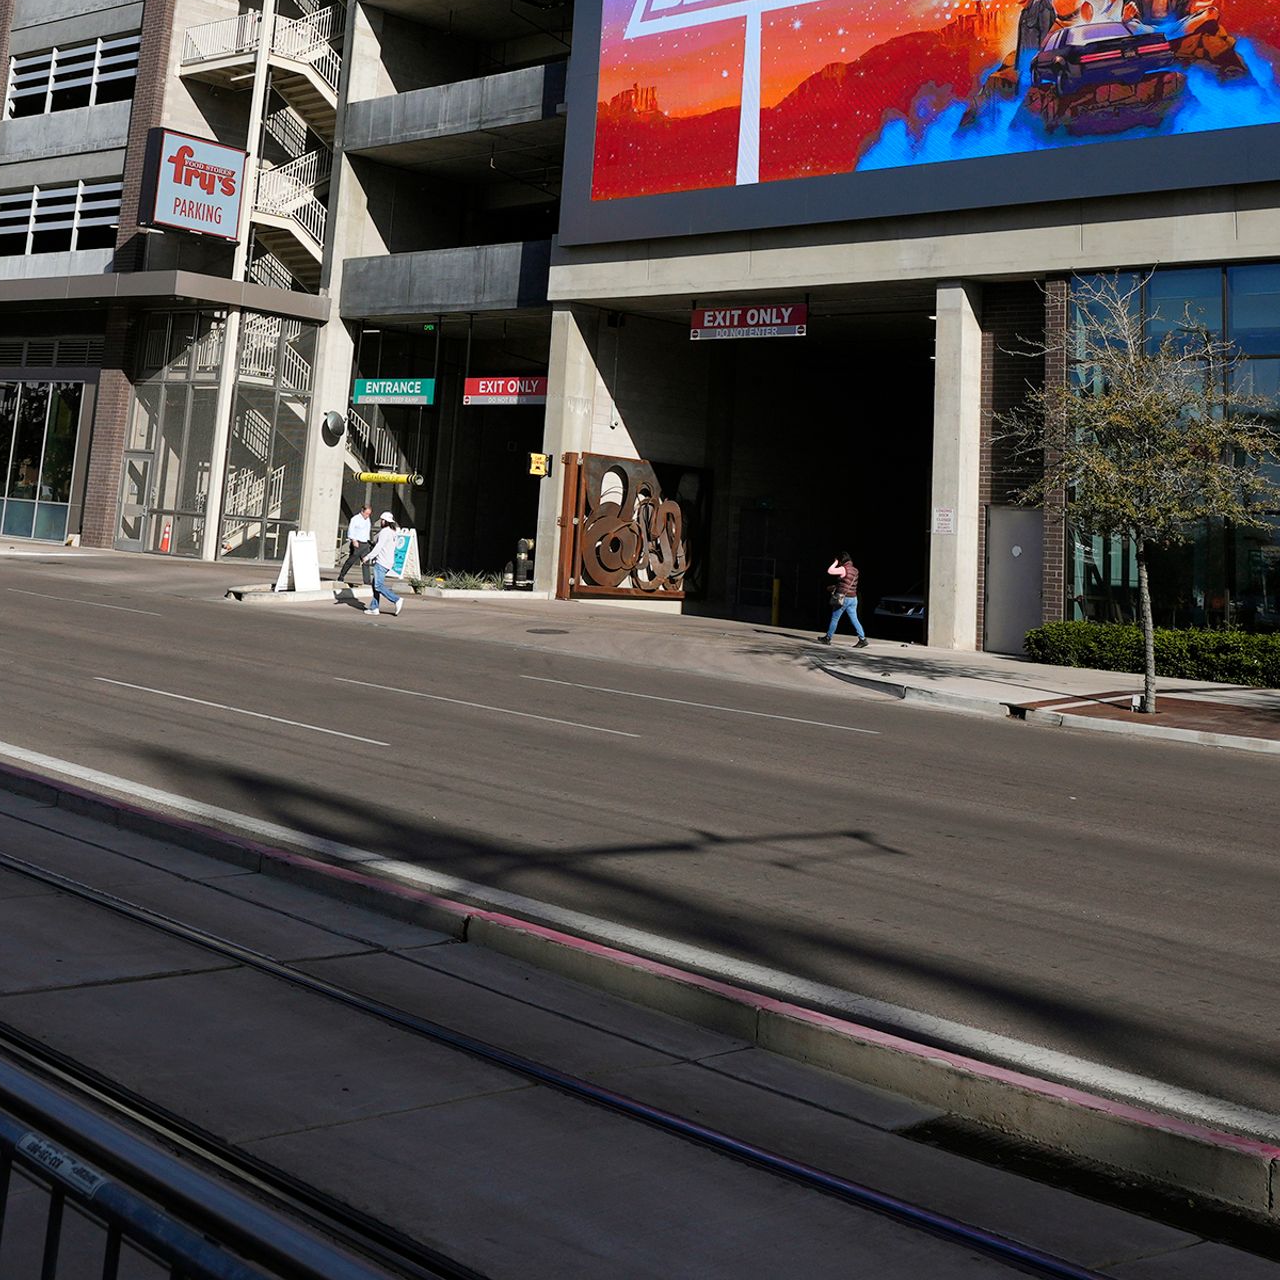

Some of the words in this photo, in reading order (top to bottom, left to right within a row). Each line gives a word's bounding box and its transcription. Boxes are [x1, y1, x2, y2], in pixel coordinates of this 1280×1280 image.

[167, 145, 236, 196] fry's
[184, 159, 204, 170] FOOD
[173, 197, 223, 224] PARKING
[703, 310, 742, 327] EXIT
[746, 307, 793, 325] ONLY
[716, 329, 728, 338] DO
[728, 328, 748, 337] NOT
[750, 327, 778, 336] ENTER
[365, 381, 421, 393] ENTRANCE
[479, 381, 505, 393] EXIT
[507, 381, 538, 393] ONLY
